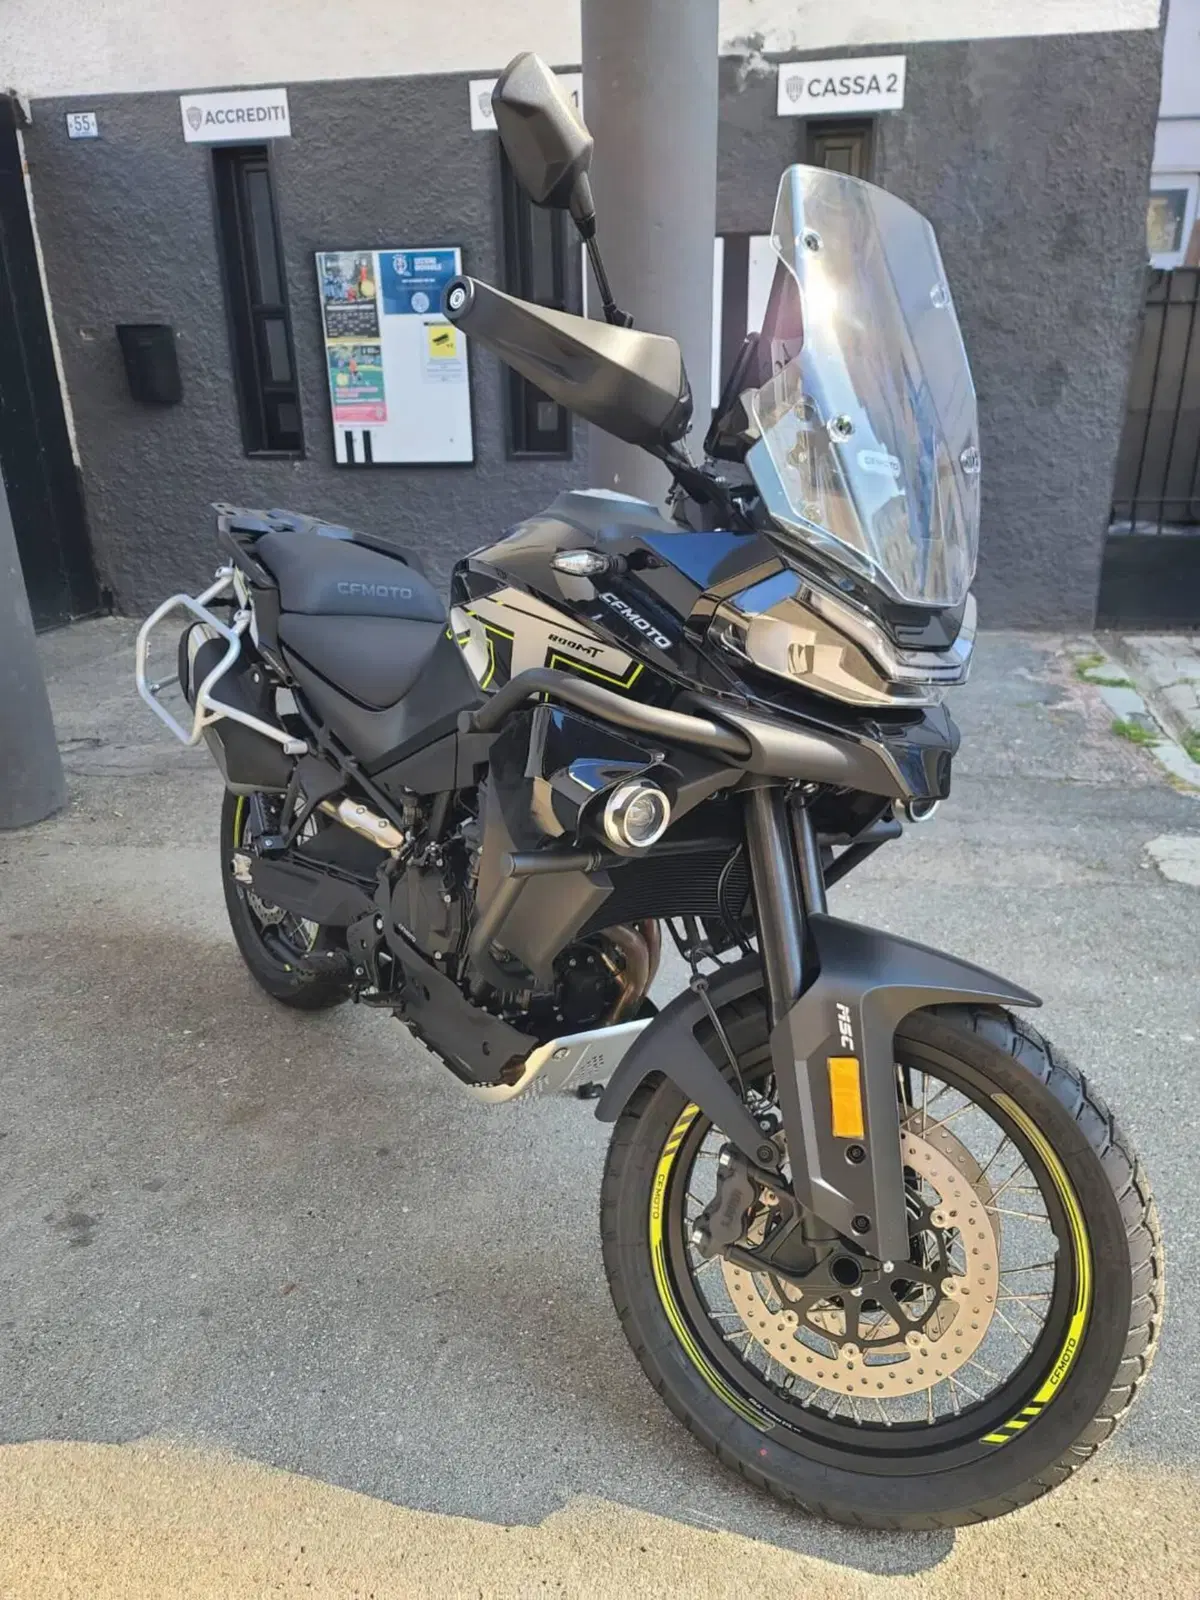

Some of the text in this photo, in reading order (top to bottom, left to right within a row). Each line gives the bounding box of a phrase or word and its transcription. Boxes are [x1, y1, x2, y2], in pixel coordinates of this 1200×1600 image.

[807, 73, 898, 98] CASSA 2
[571, 90, 579, 108] 1
[74, 115, 90, 131] 55
[205, 105, 286, 126] ACCREDITI
[337, 582, 412, 600] CFMOTO
[600, 591, 673, 649] CFMOTO
[548, 633, 604, 658] 800MT
[652, 1173, 666, 1220] CFMOTO
[1050, 1337, 1077, 1386] CFMOTO
